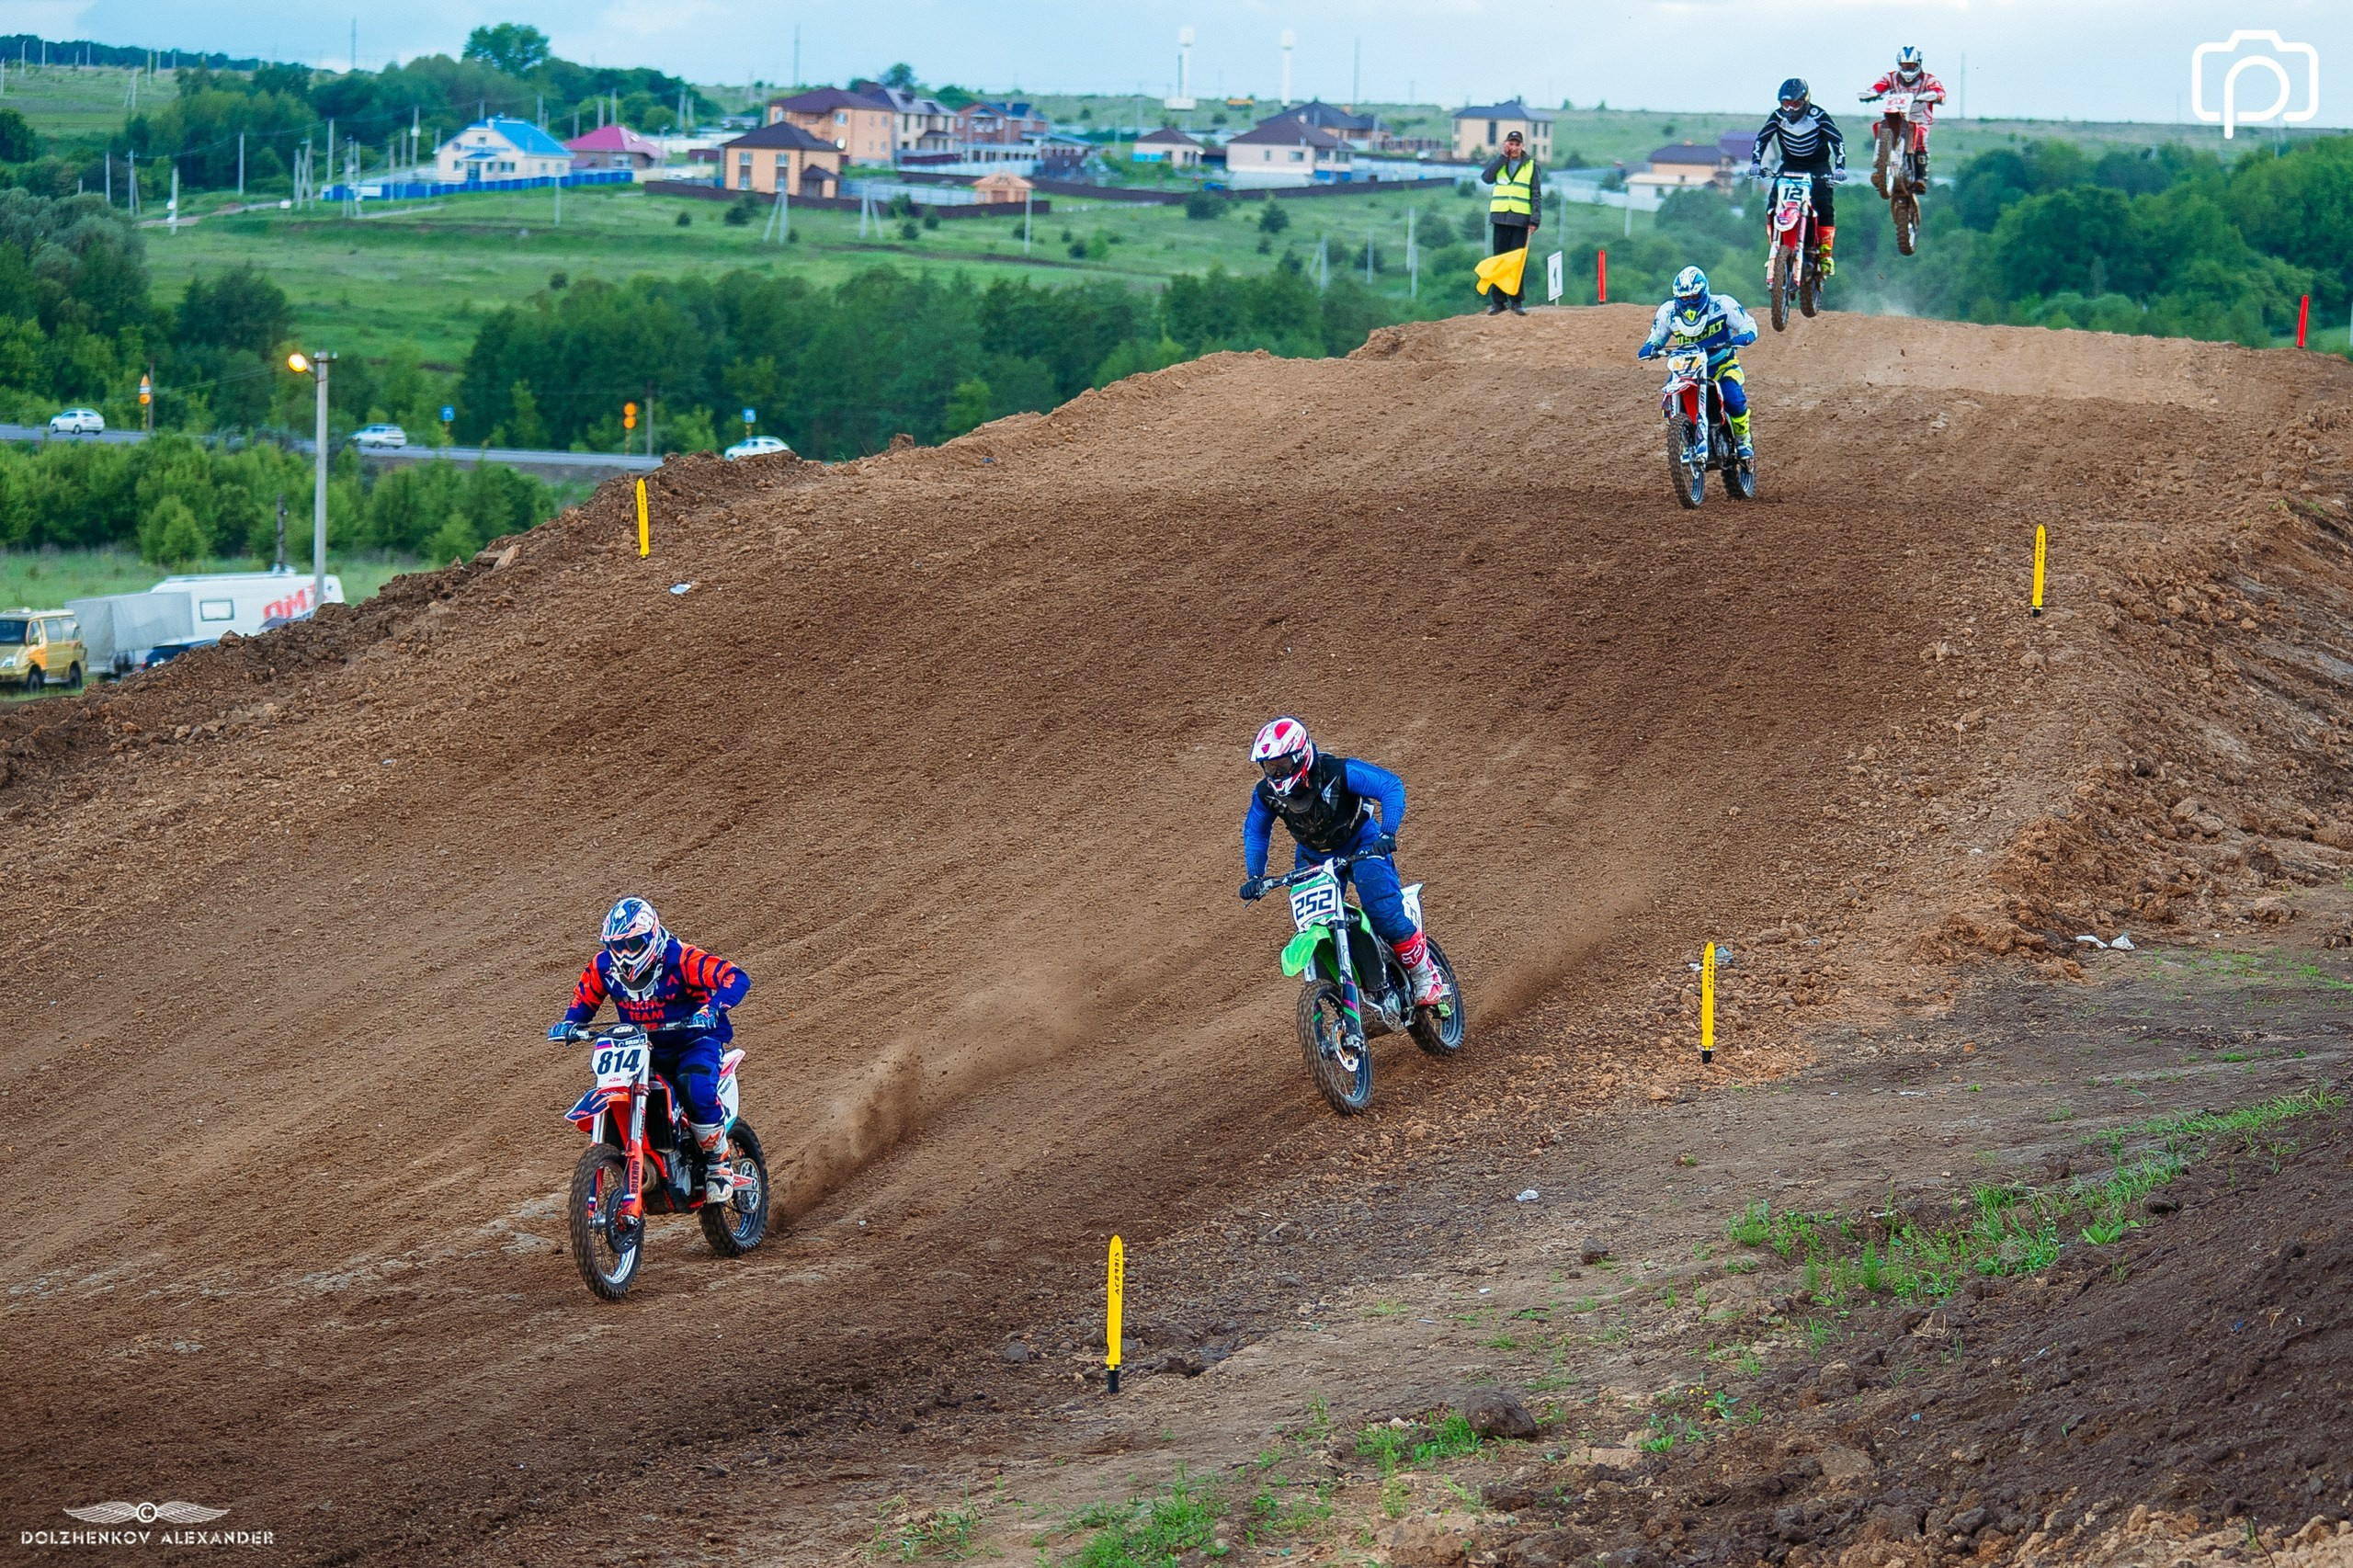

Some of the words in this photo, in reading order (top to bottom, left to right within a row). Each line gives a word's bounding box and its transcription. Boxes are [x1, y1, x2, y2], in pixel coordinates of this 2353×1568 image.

[1783, 187, 1804, 200] 12
[1684, 356, 1698, 373] 7
[1295, 889, 1333, 921] 252
[629, 1009, 665, 1021] TEAM
[597, 1049, 642, 1075] 814
[631, 1160, 640, 1195] BOLKHOV
